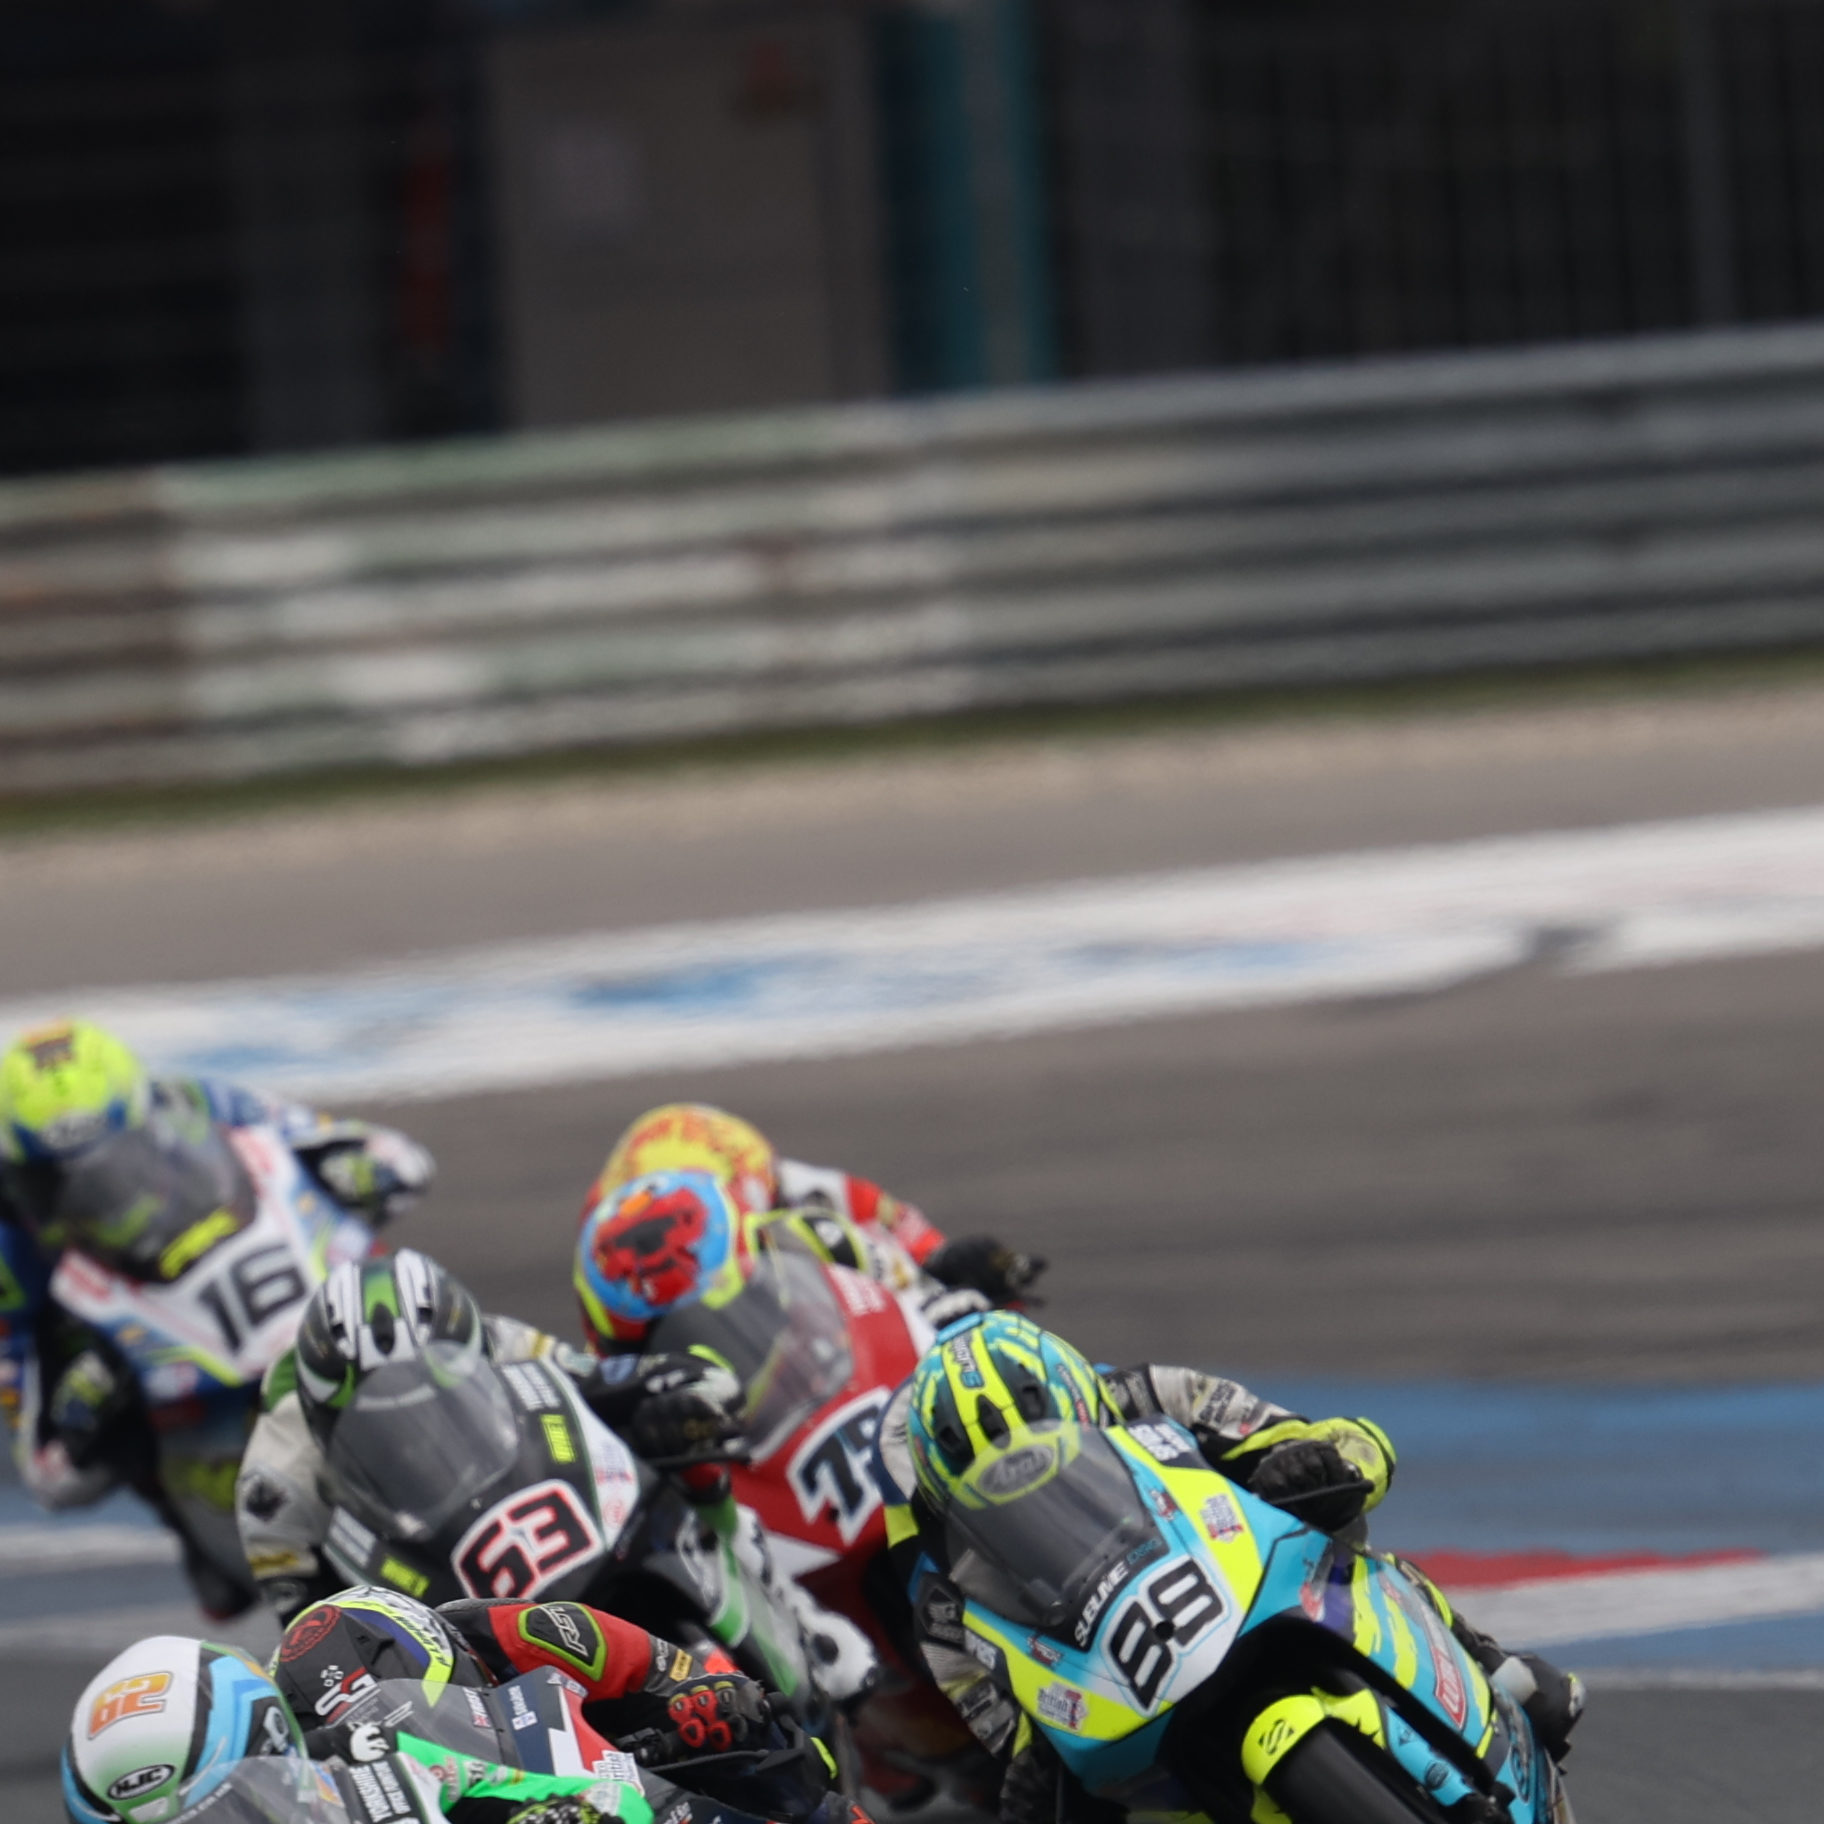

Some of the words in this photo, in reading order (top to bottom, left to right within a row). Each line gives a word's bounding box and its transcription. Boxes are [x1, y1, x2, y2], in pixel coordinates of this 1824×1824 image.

[196, 1242, 307, 1356] 16
[459, 1487, 596, 1601] 63
[1110, 1557, 1224, 1711] 89
[116, 1766, 166, 1794] HJC
